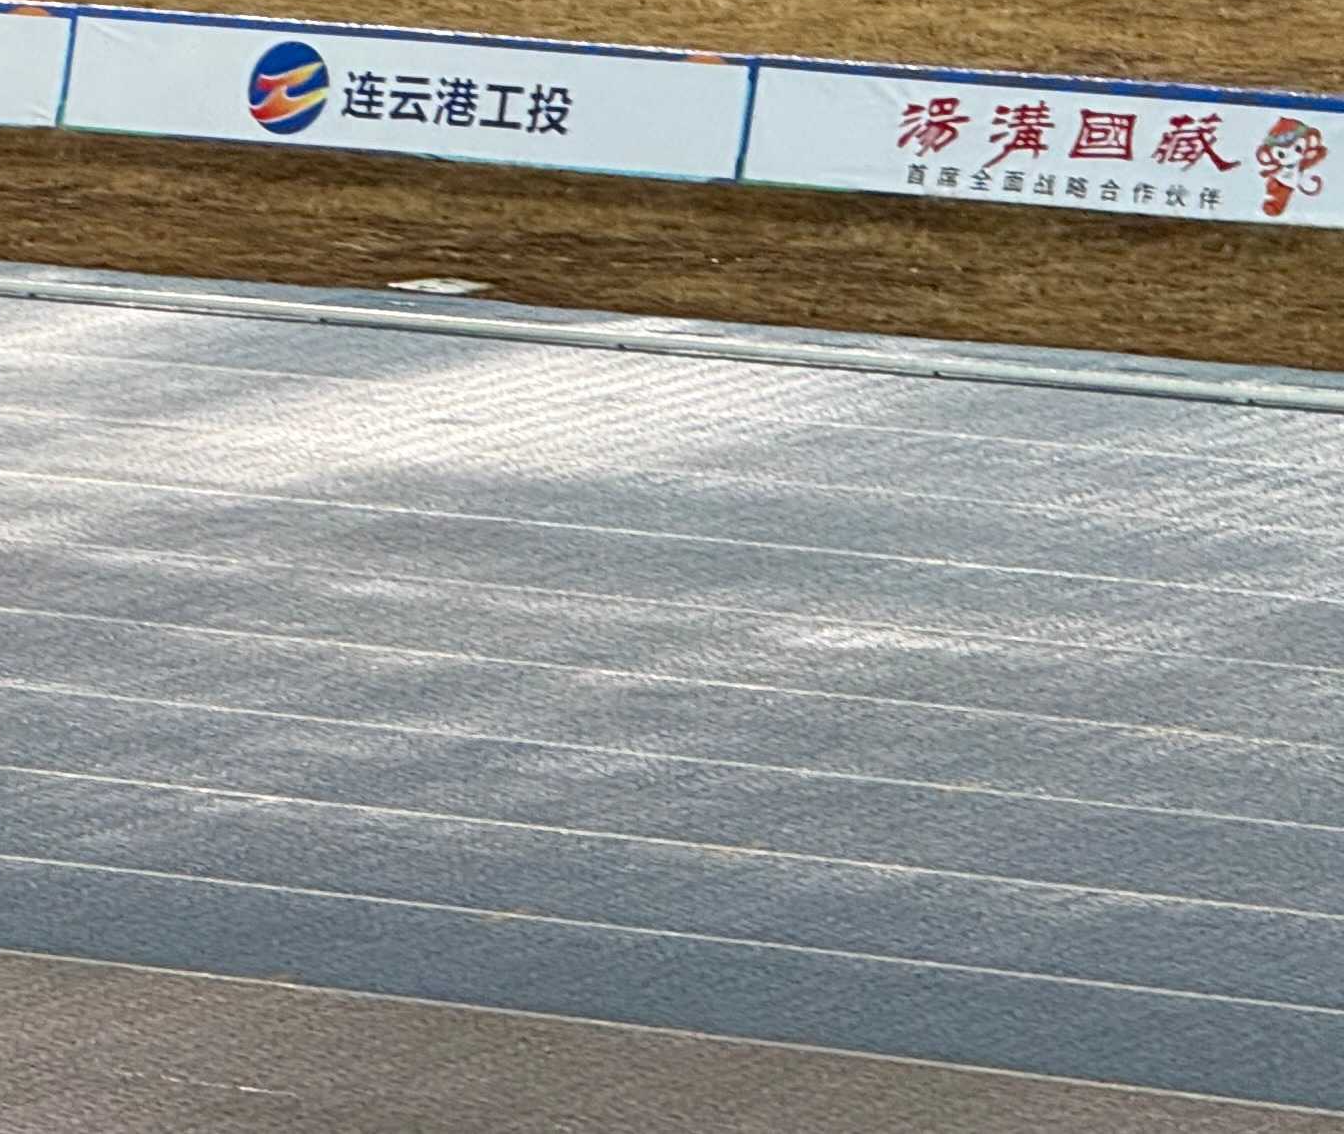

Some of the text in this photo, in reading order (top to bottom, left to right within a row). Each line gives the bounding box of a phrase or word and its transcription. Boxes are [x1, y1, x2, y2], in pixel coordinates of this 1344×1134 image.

[342, 71, 573, 135] 连云港工投
[906, 163, 1223, 211] 首席全面战略合作伙伴
